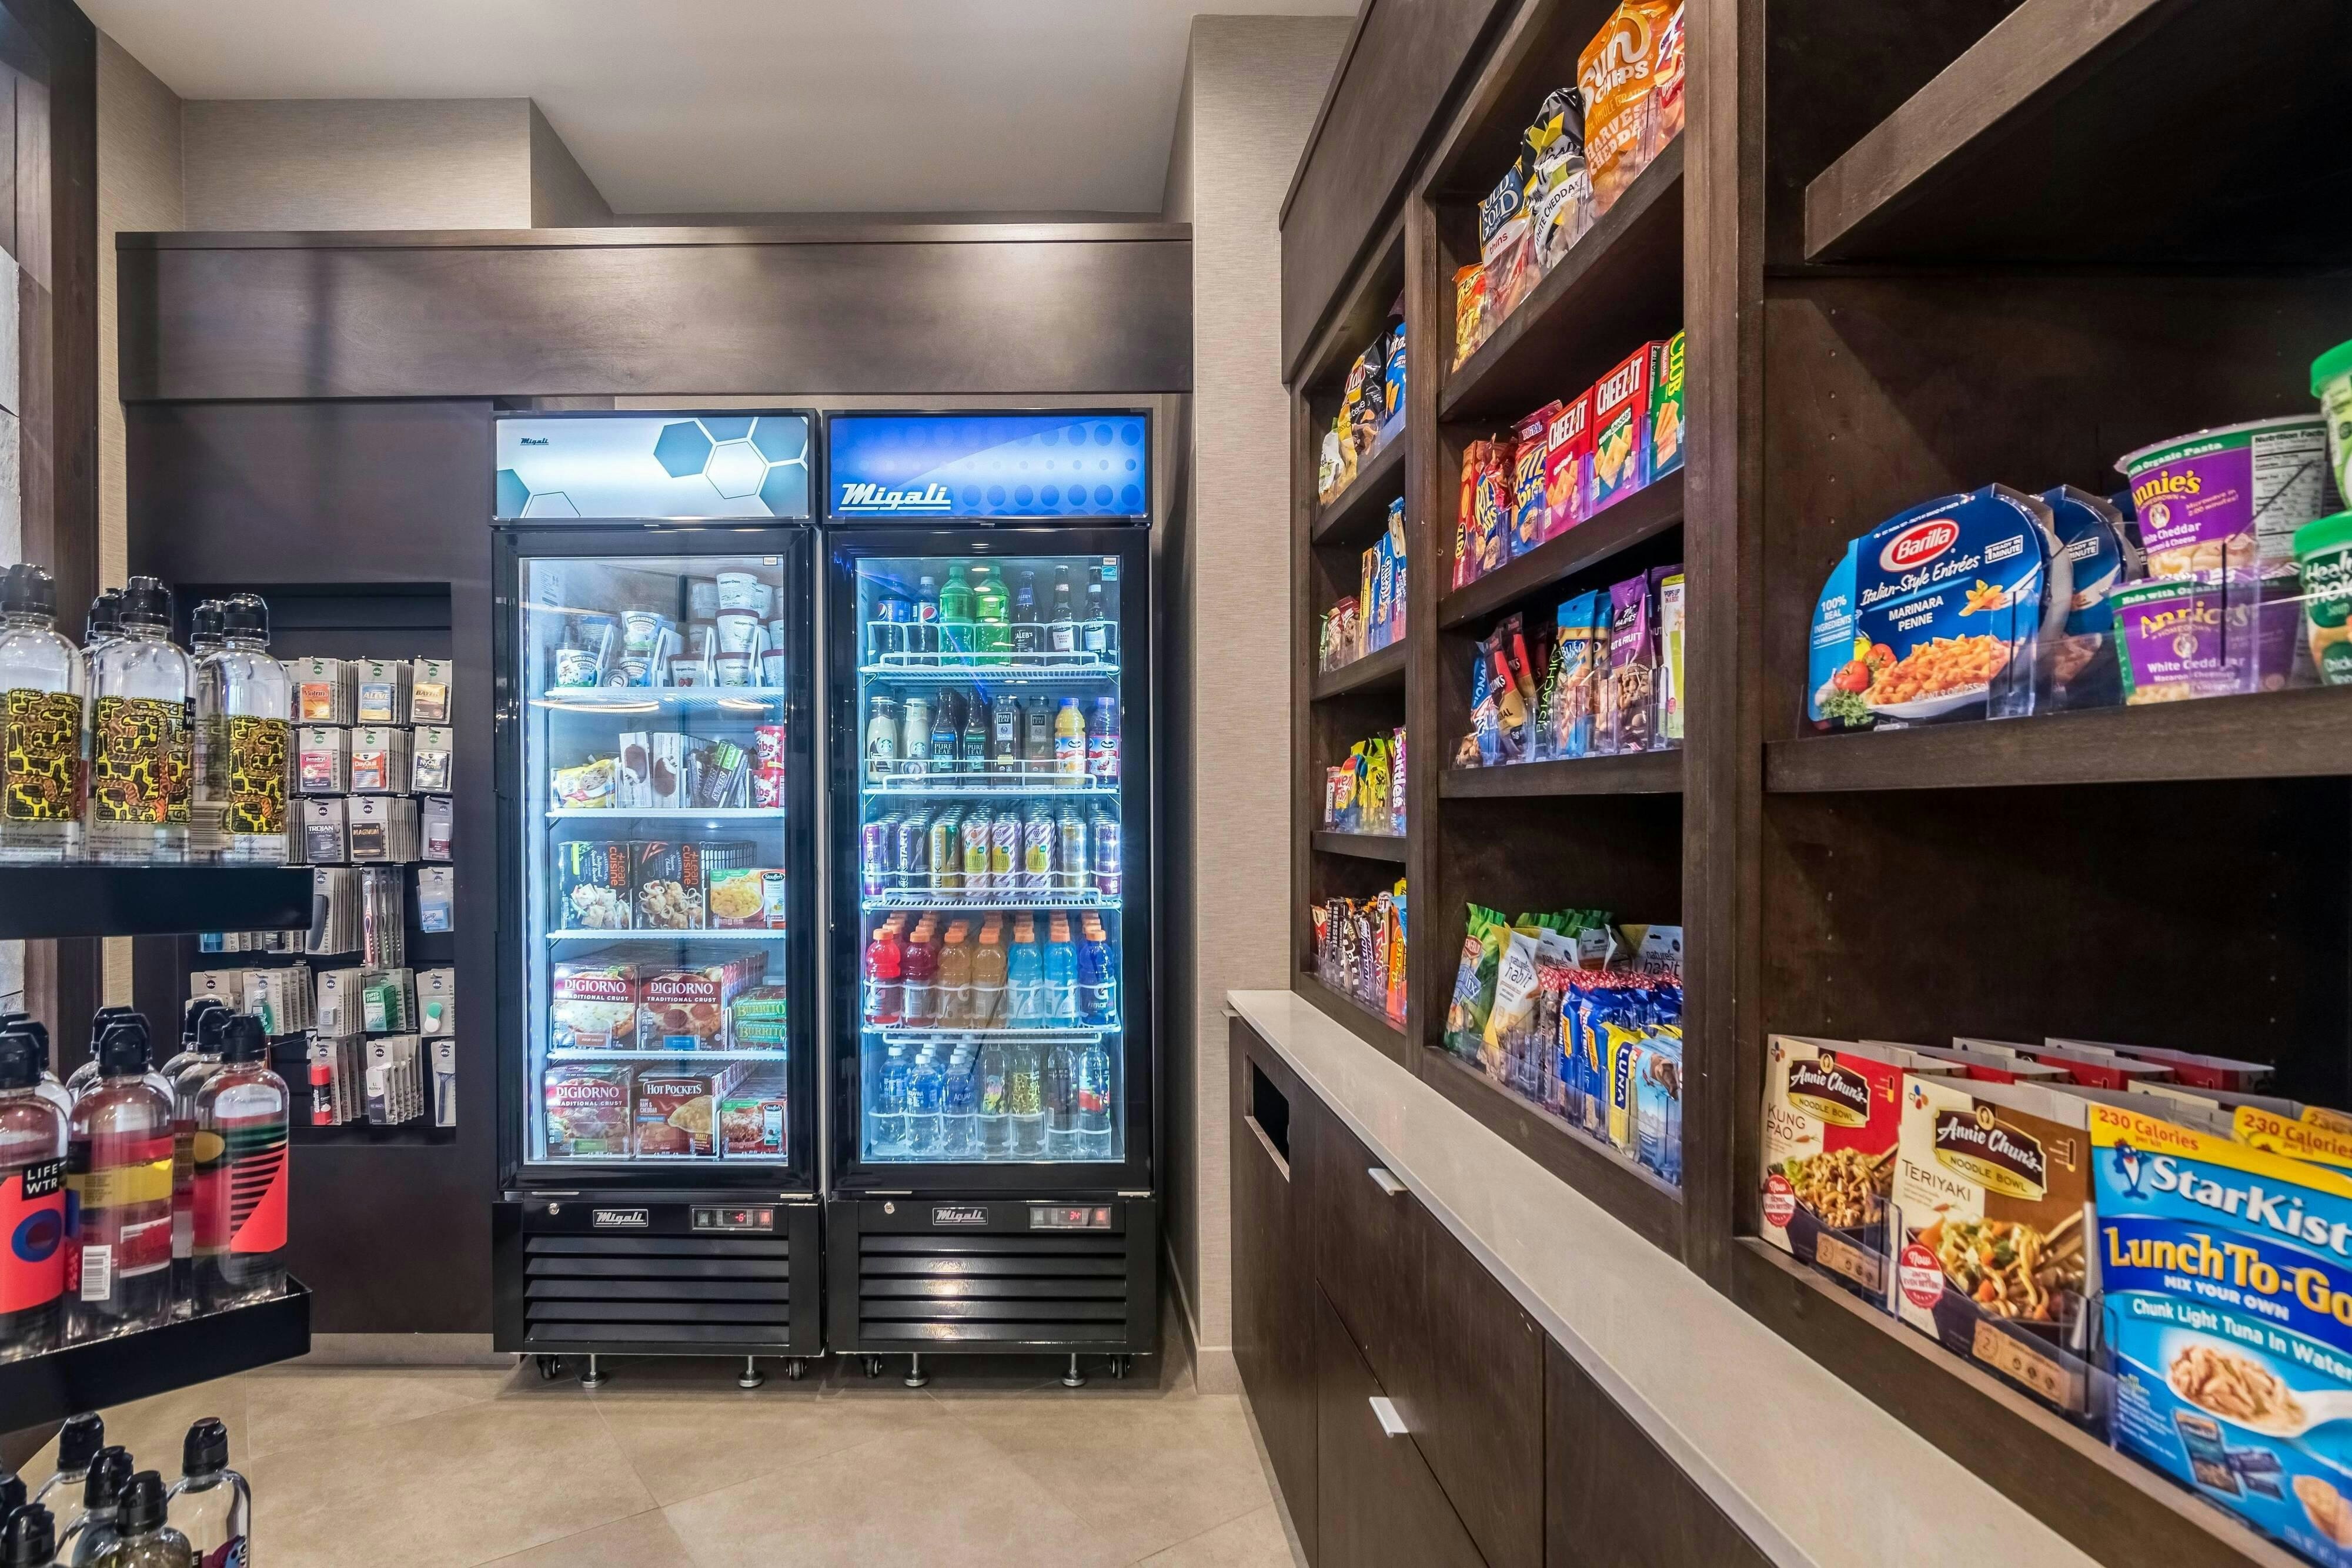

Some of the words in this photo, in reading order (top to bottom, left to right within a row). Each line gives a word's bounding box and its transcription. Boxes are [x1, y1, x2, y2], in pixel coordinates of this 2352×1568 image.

[1594, 60, 1649, 104] CHIPS
[1593, 98, 1616, 126] WHOLE
[1482, 189, 1519, 242] GOLD
[1489, 232, 1508, 255] thins
[520, 437, 549, 446] Migali
[2255, 432, 2298, 443] Nutrition
[2143, 451, 2182, 469] Organic
[2183, 442, 2223, 456] Pasta
[838, 483, 951, 510] Migali
[2157, 522, 2201, 540] Cheddar
[2170, 535, 2197, 548] Cheese
[1896, 527, 1952, 561] Barilla
[1992, 541, 2012, 552] READY
[1992, 544, 2021, 560] MINUTE
[1859, 566, 1930, 606] Italian-Style
[1932, 554, 1981, 582] Entrées
[1821, 594, 1847, 612] 100%
[2122, 594, 2146, 605] Made
[2147, 589, 2175, 600] with
[1824, 609, 1842, 621] REAL
[1888, 595, 1944, 622] MARINARA
[2326, 603, 2350, 617] Soup
[1813, 614, 1852, 634] INGREDIENTS
[1897, 612, 1933, 632] PENNE
[1622, 632, 1643, 644] FRUIT
[2147, 661, 2180, 673] White
[363, 691, 389, 700] ALEVE
[712, 772, 727, 801] SNICKERS
[609, 847, 618, 886] cuisine
[683, 845, 691, 884] cuisine
[690, 859, 699, 885] Lean
[1510, 955, 1531, 973] nature's
[1646, 948, 1675, 961] nature's
[1505, 962, 1532, 988] habit
[1643, 959, 1681, 977] habit
[651, 982, 714, 994] DIGIORNO
[737, 1004, 786, 1017] BURRITO
[1617, 1048, 1628, 1102] LUNA
[1789, 1065, 1826, 1088] Annie
[1828, 1072, 1867, 1104] Chun's
[647, 1085, 664, 1094] HOT
[666, 1084, 703, 1095] POCKETS
[1768, 1102, 1806, 1129] KUNG
[1799, 1098, 1829, 1114] NOODLE
[1832, 1107, 1855, 1122] BOWL
[1766, 1120, 1793, 1141] PAO
[2099, 1108, 2131, 1131] 230
[2134, 1119, 2199, 1152] Calories
[2243, 1114, 2280, 1136] 230
[1936, 1116, 1986, 1145] Annie
[1988, 1129, 2043, 1174] Chun's
[27, 1163, 58, 1181] LIFE
[1902, 1158, 1971, 1202] TERIYAKI
[1950, 1156, 1992, 1179] NOODLE
[1996, 1173, 2028, 1193] BOWL
[26, 1177, 58, 1195] WTR
[936, 1209, 987, 1223] Migali
[2150, 1155, 2352, 1256] StarKist
[596, 1211, 646, 1225] Migali
[1908, 1251, 1932, 1268] Now
[2104, 1226, 2224, 1281] Lunch
[2164, 1275, 2192, 1293] MIX
[2195, 1283, 2242, 1309] YOUR
[2243, 1295, 2290, 1322] OWN
[2132, 1299, 2174, 1320] Chunk
[2176, 1308, 2219, 1338] Light
[2221, 1316, 2264, 1345] Tuna
[2269, 1331, 2287, 1352] In
